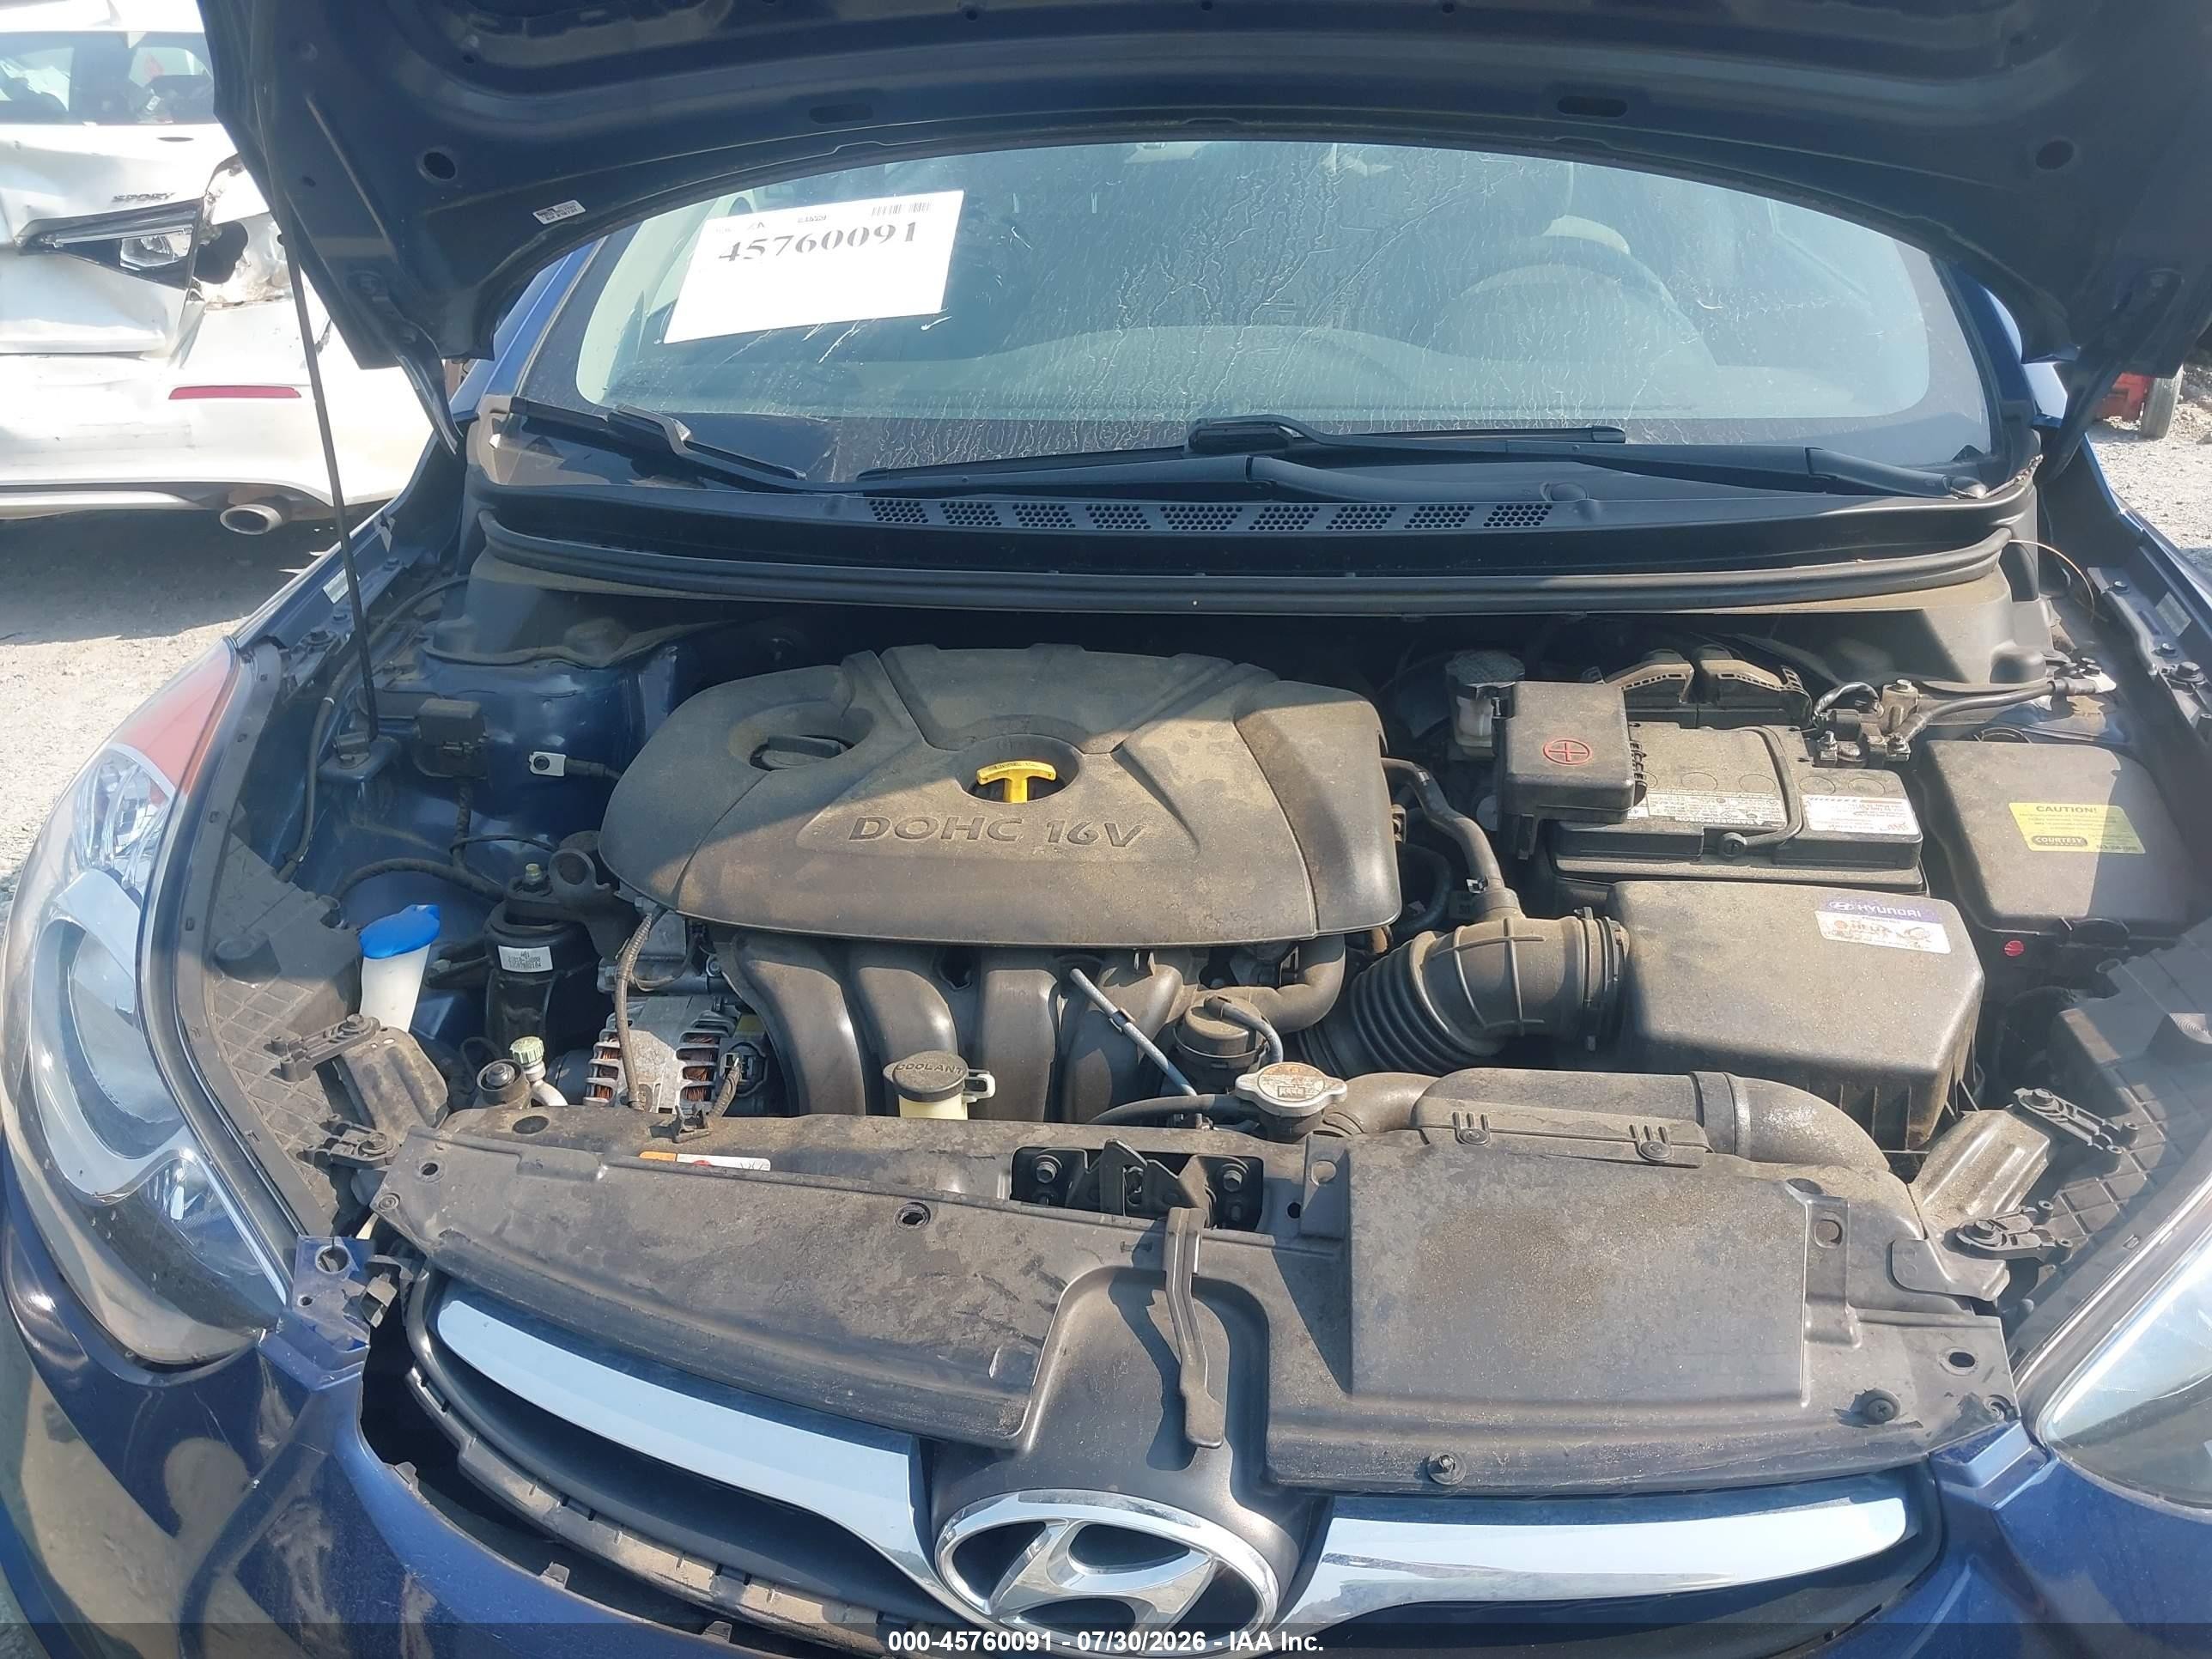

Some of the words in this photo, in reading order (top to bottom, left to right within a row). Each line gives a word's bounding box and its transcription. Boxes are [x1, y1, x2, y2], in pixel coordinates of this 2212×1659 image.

[718, 221, 918, 263] 45760091
[2035, 805, 2098, 814] CAUTION!
[848, 815, 1025, 842] DOHC
[1046, 819, 1146, 848] 16V
[1856, 903, 1923, 918] HYUNDAI
[895, 1062, 963, 1075] COOLANT
